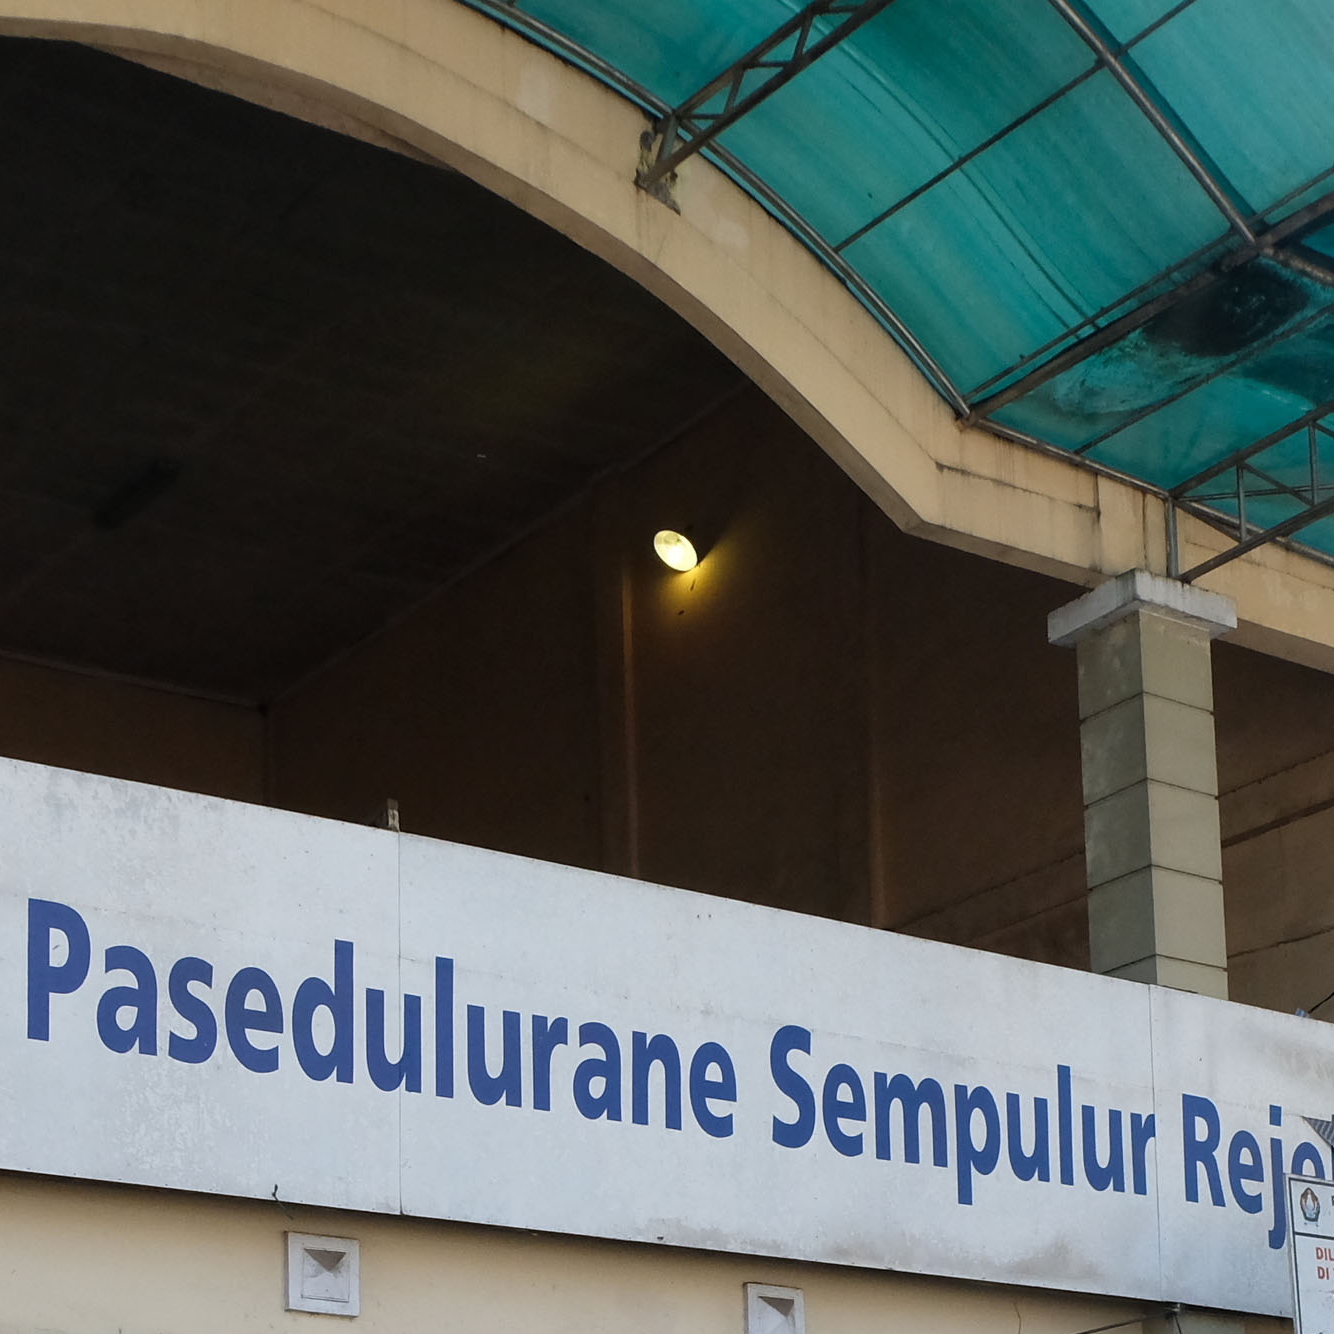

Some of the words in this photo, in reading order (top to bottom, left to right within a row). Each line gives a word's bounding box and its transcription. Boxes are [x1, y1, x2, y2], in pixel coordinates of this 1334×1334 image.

[26, 898, 738, 1138] Pasedulurane
[770, 1025, 1156, 1205] Sempulur
[1317, 1266, 1330, 1280] DI
